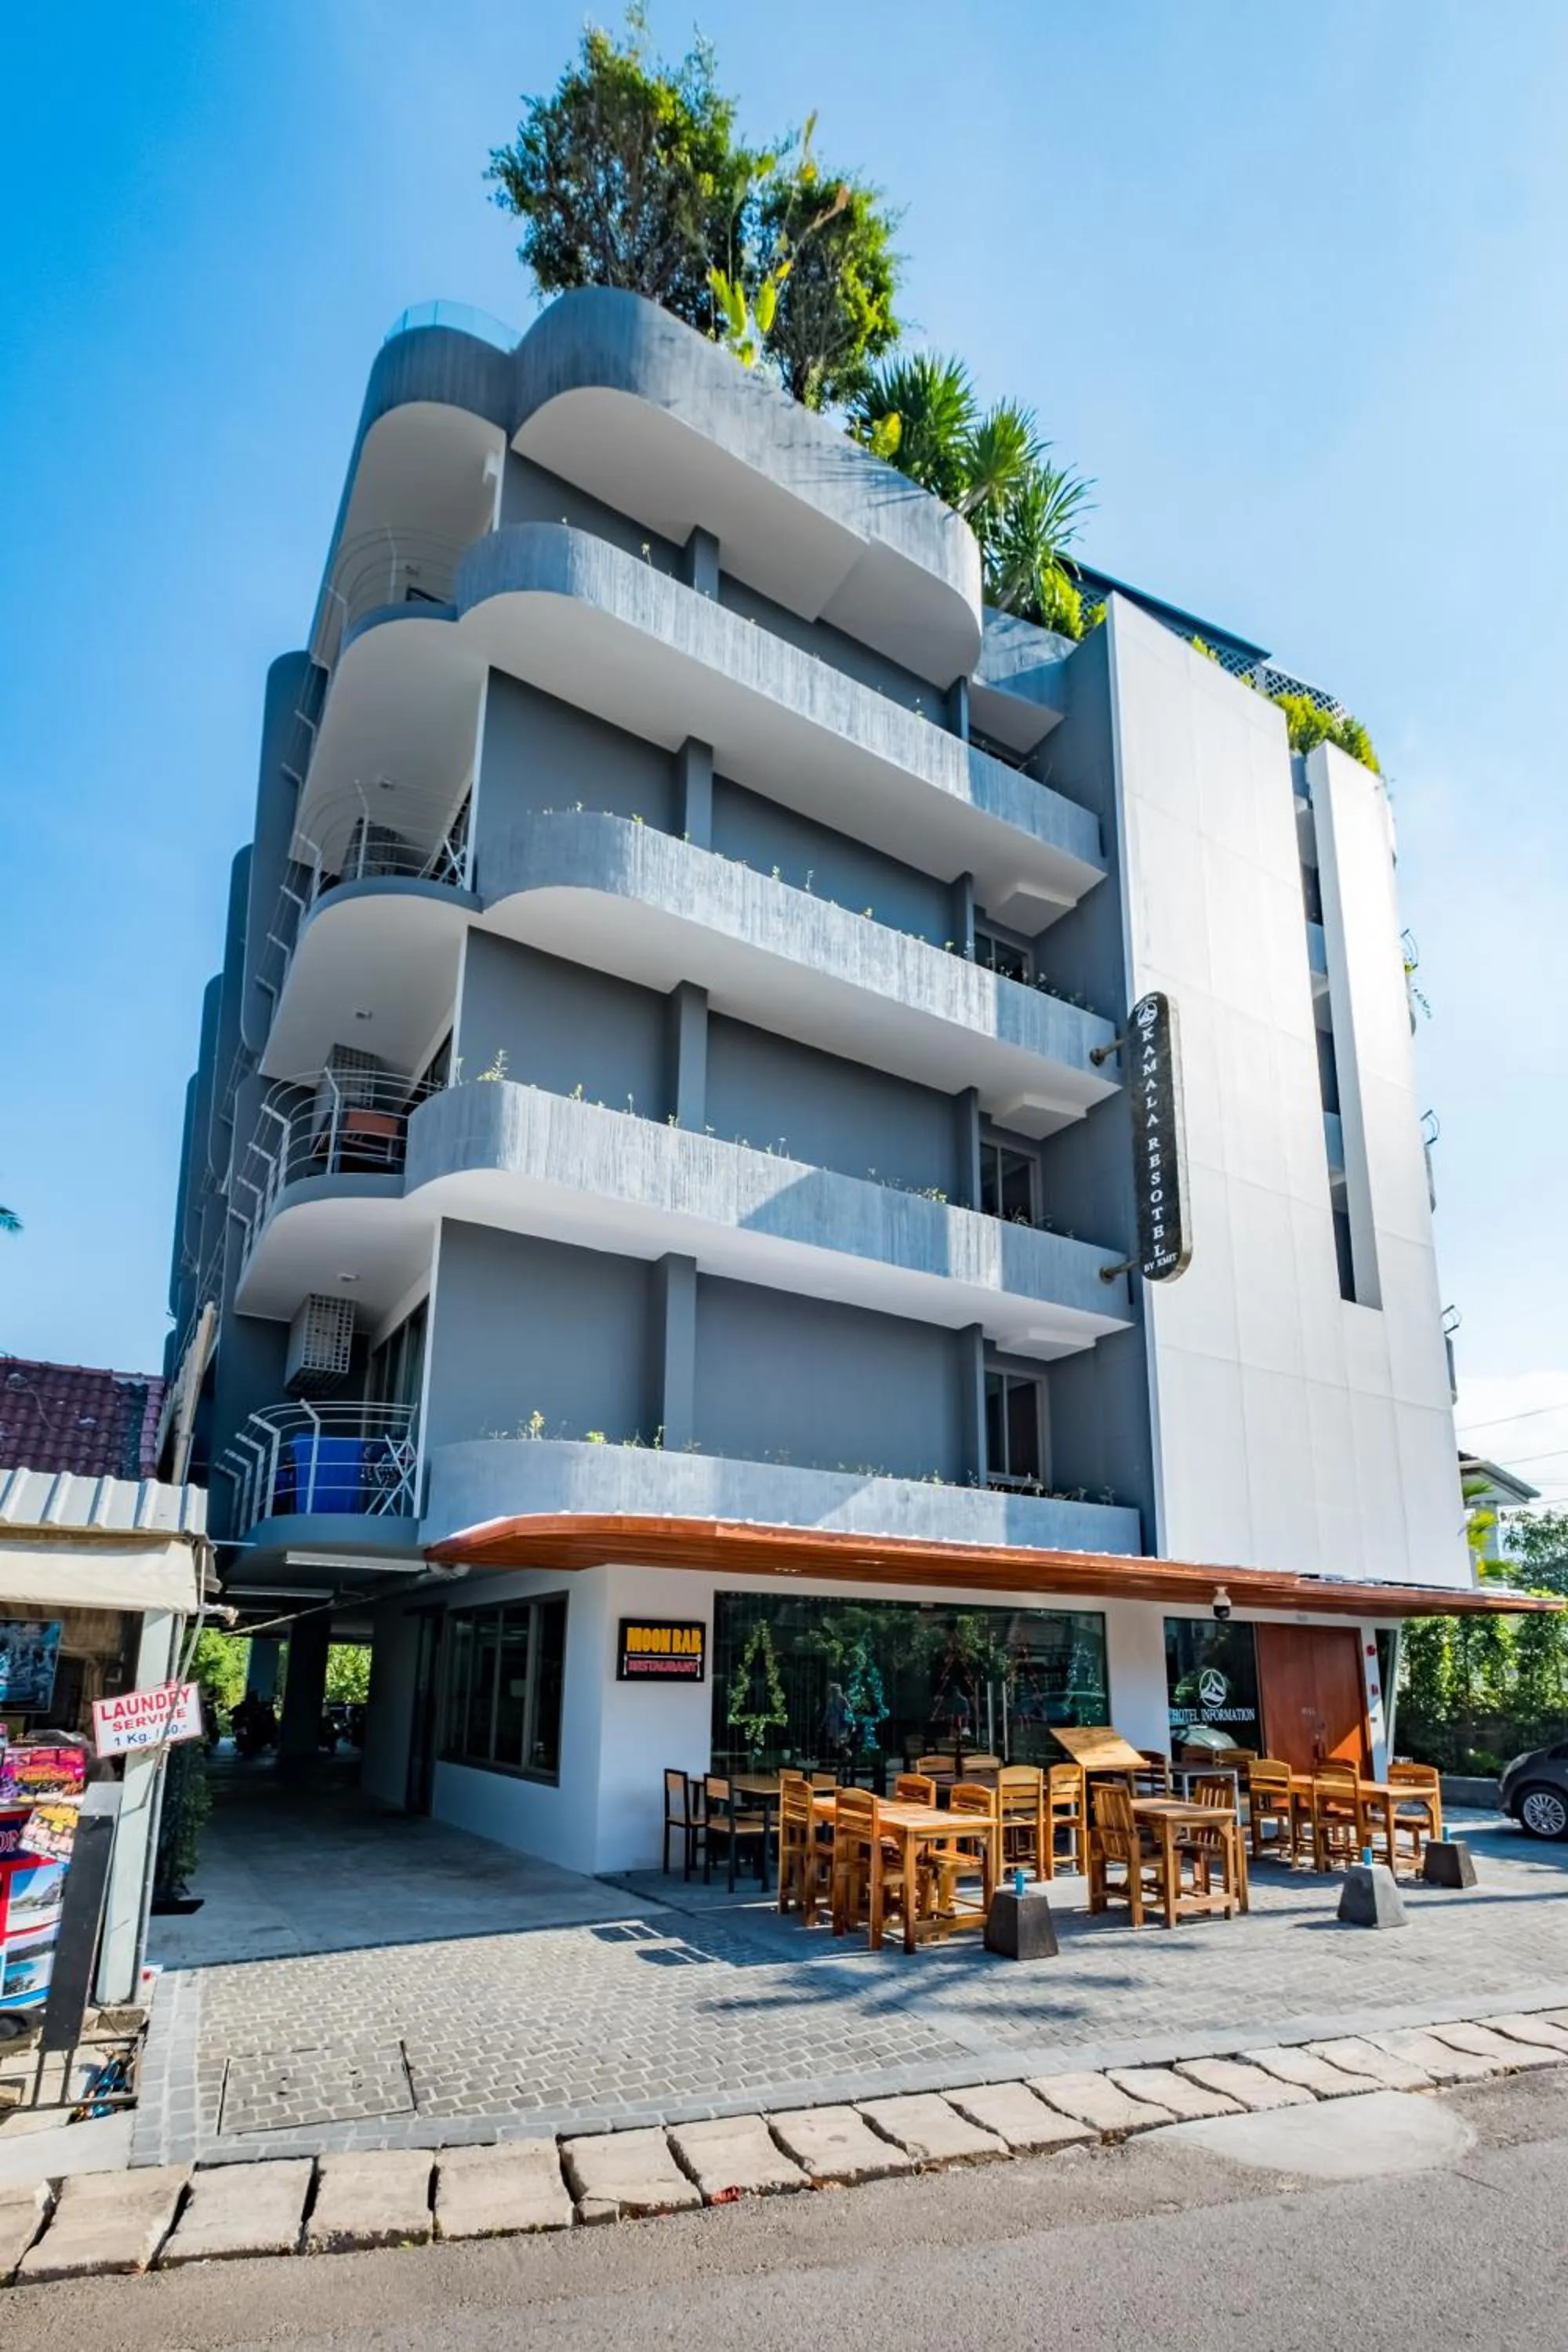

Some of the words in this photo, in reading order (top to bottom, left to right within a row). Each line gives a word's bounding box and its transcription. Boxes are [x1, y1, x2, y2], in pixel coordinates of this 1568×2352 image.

[1142, 1026, 1160, 1130] KAMALA
[626, 1627, 671, 1653] MOON
[672, 1628, 702, 1654] BAR
[1171, 1708, 1200, 1722] HOTEL
[1201, 1708, 1255, 1722] INFORMATION
